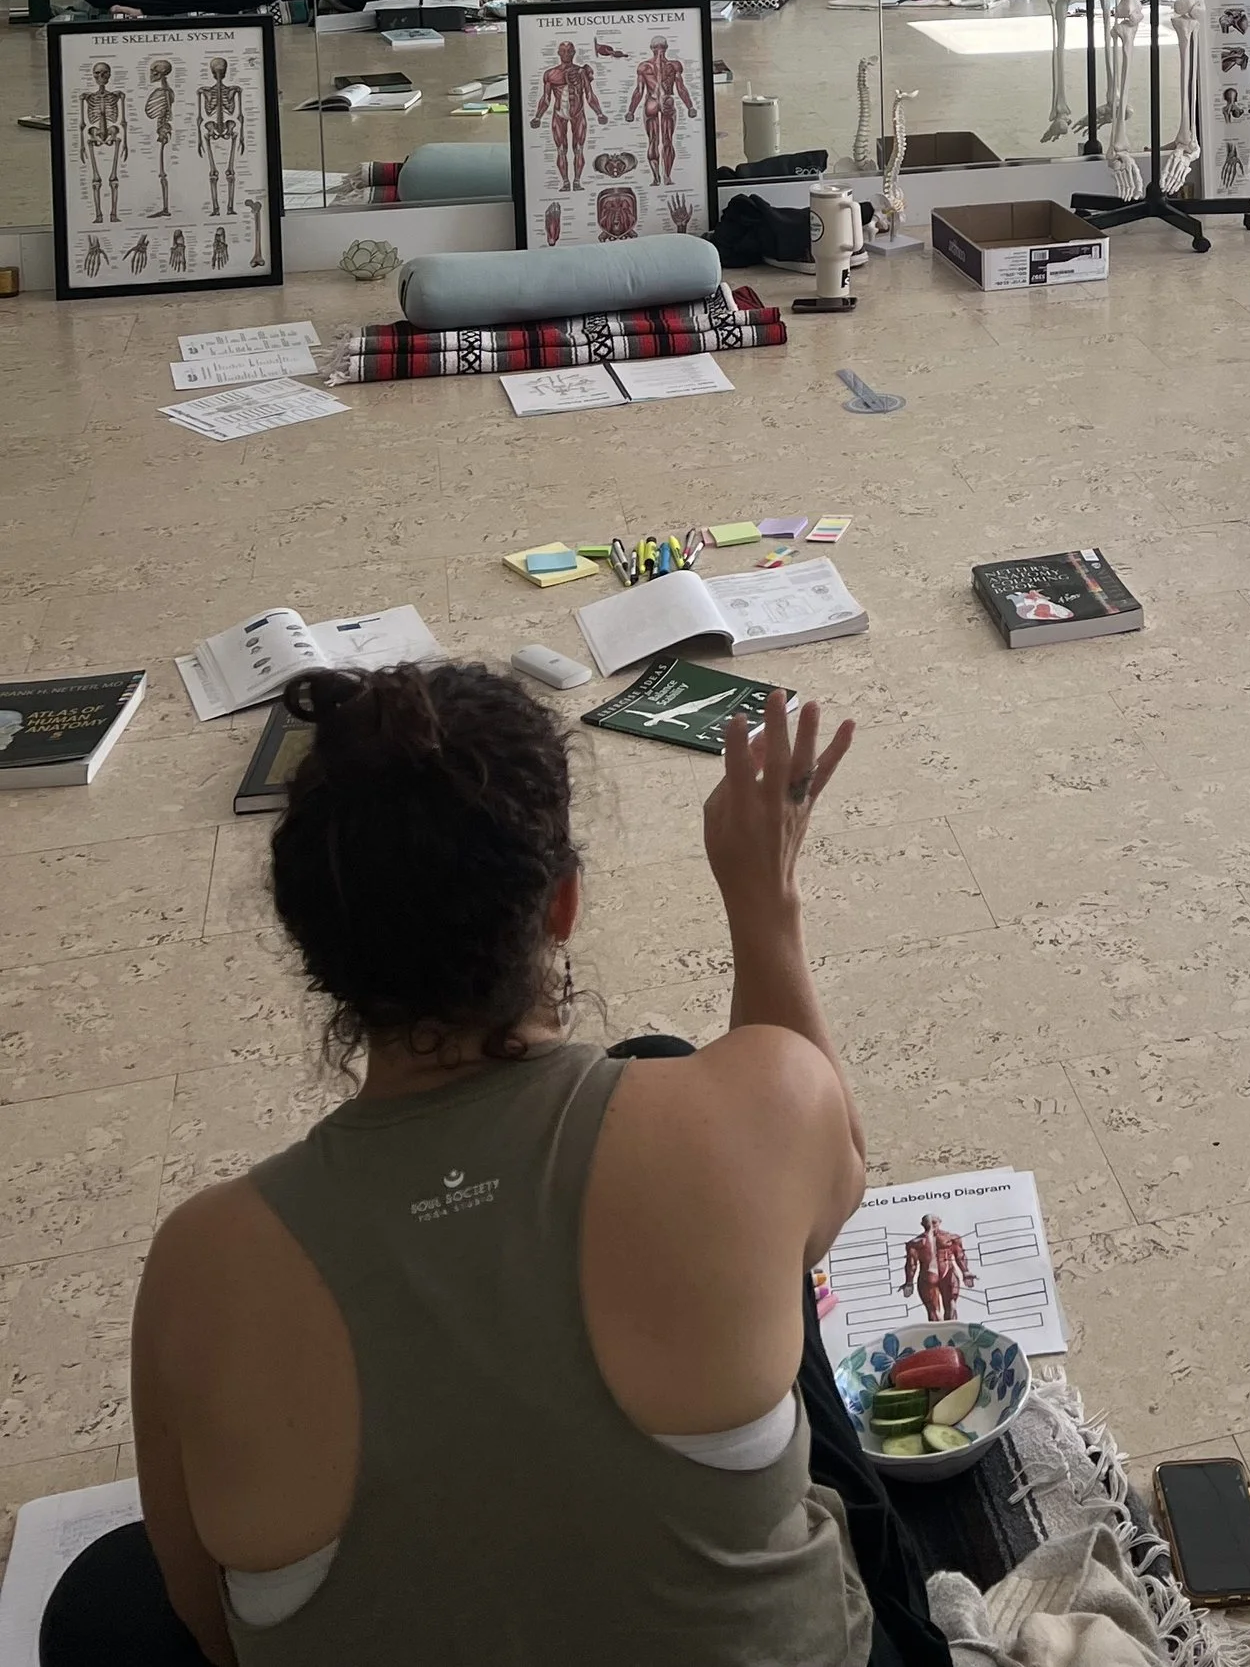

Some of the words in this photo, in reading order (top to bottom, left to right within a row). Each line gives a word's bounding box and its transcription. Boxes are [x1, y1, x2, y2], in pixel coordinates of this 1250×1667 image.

[537, 17, 563, 28] THE
[566, 14, 635, 27] MUSCULAR
[638, 12, 686, 23] SYSTEM
[92, 35, 118, 45] THE
[122, 33, 183, 44] SKELETAL
[187, 31, 235, 41] SYSTEM
[988, 568, 1060, 584] ANATOMY
[991, 573, 1070, 589] COLORING
[994, 582, 1038, 595] BOOK
[641, 664, 667, 690] IDEAS
[27, 708, 78, 720] ATLAS
[81, 704, 105, 714] OF
[27, 713, 91, 727] HUMAN
[24, 717, 108, 734] ANATOMY
[446, 1179, 500, 1205] SOCIETY
[892, 1190, 951, 1204] Labeling
[954, 1183, 1011, 1198] Diagram
